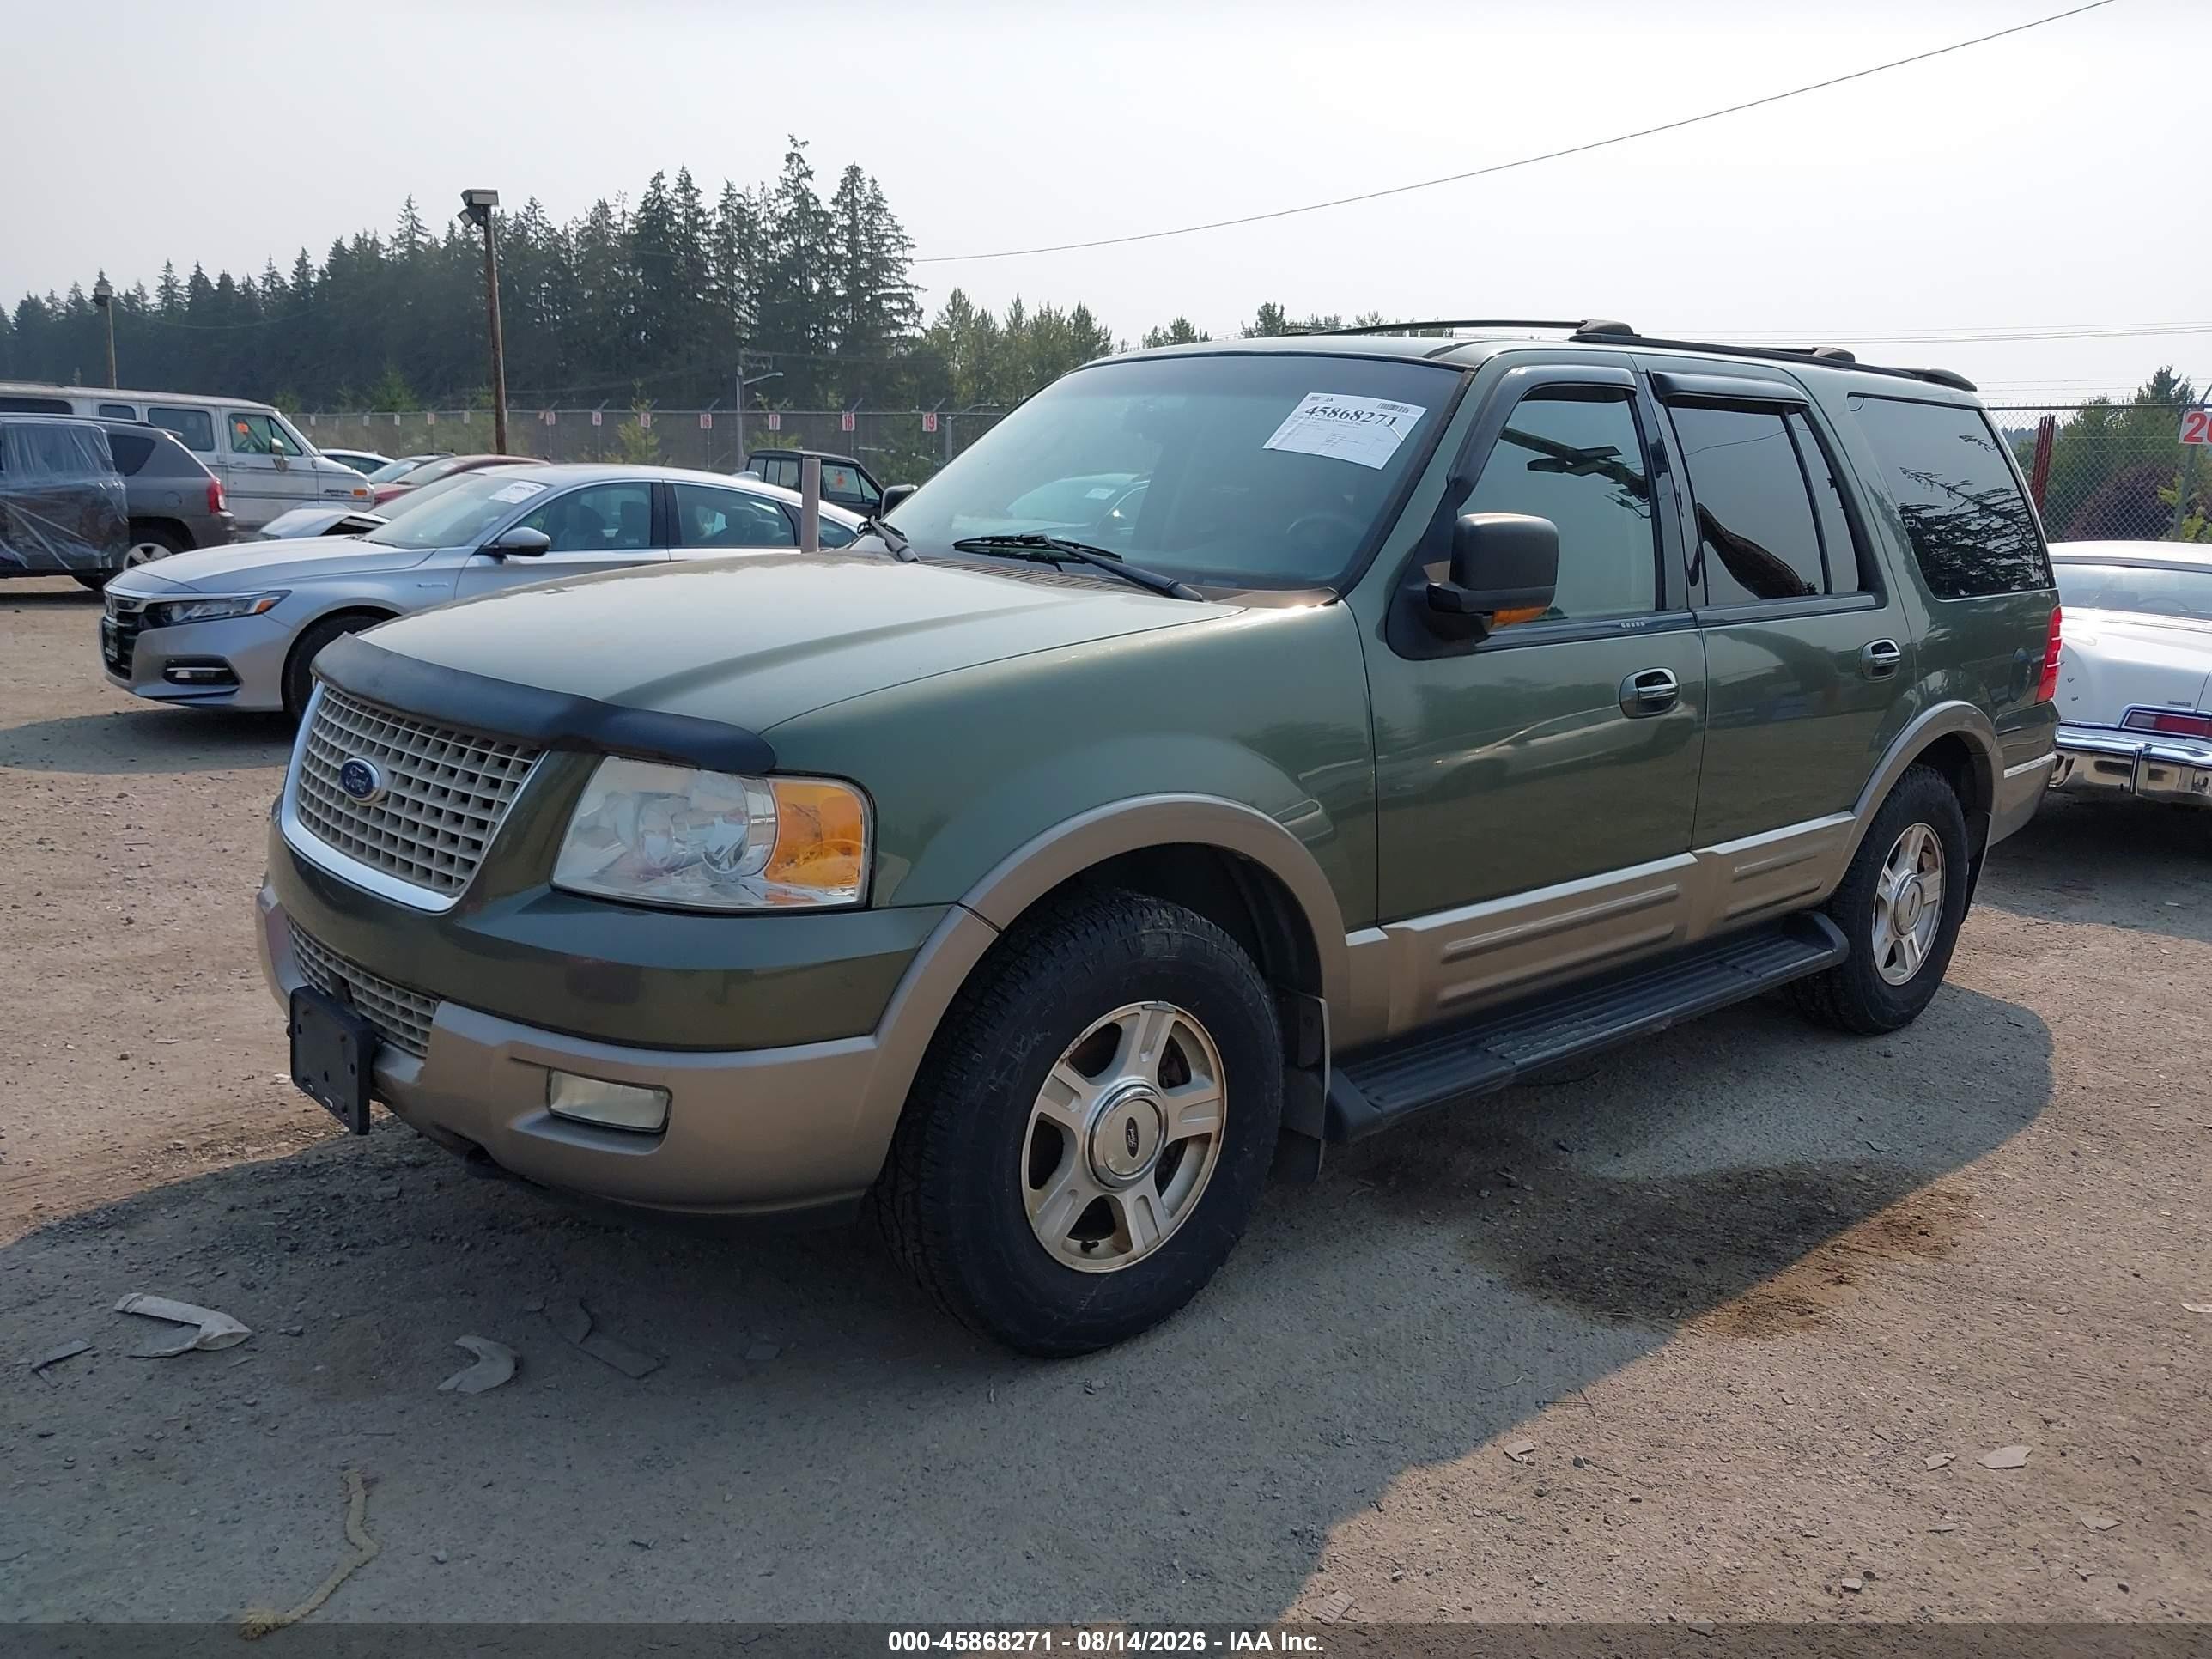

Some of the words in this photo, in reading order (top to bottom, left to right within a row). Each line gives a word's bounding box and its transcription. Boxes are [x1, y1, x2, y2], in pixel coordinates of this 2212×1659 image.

[702, 414, 710, 428] 16
[844, 414, 853, 430] 18
[925, 415, 934, 430] 19
[1304, 405, 1398, 427] 45868271
[2184, 412, 2212, 443] 2
